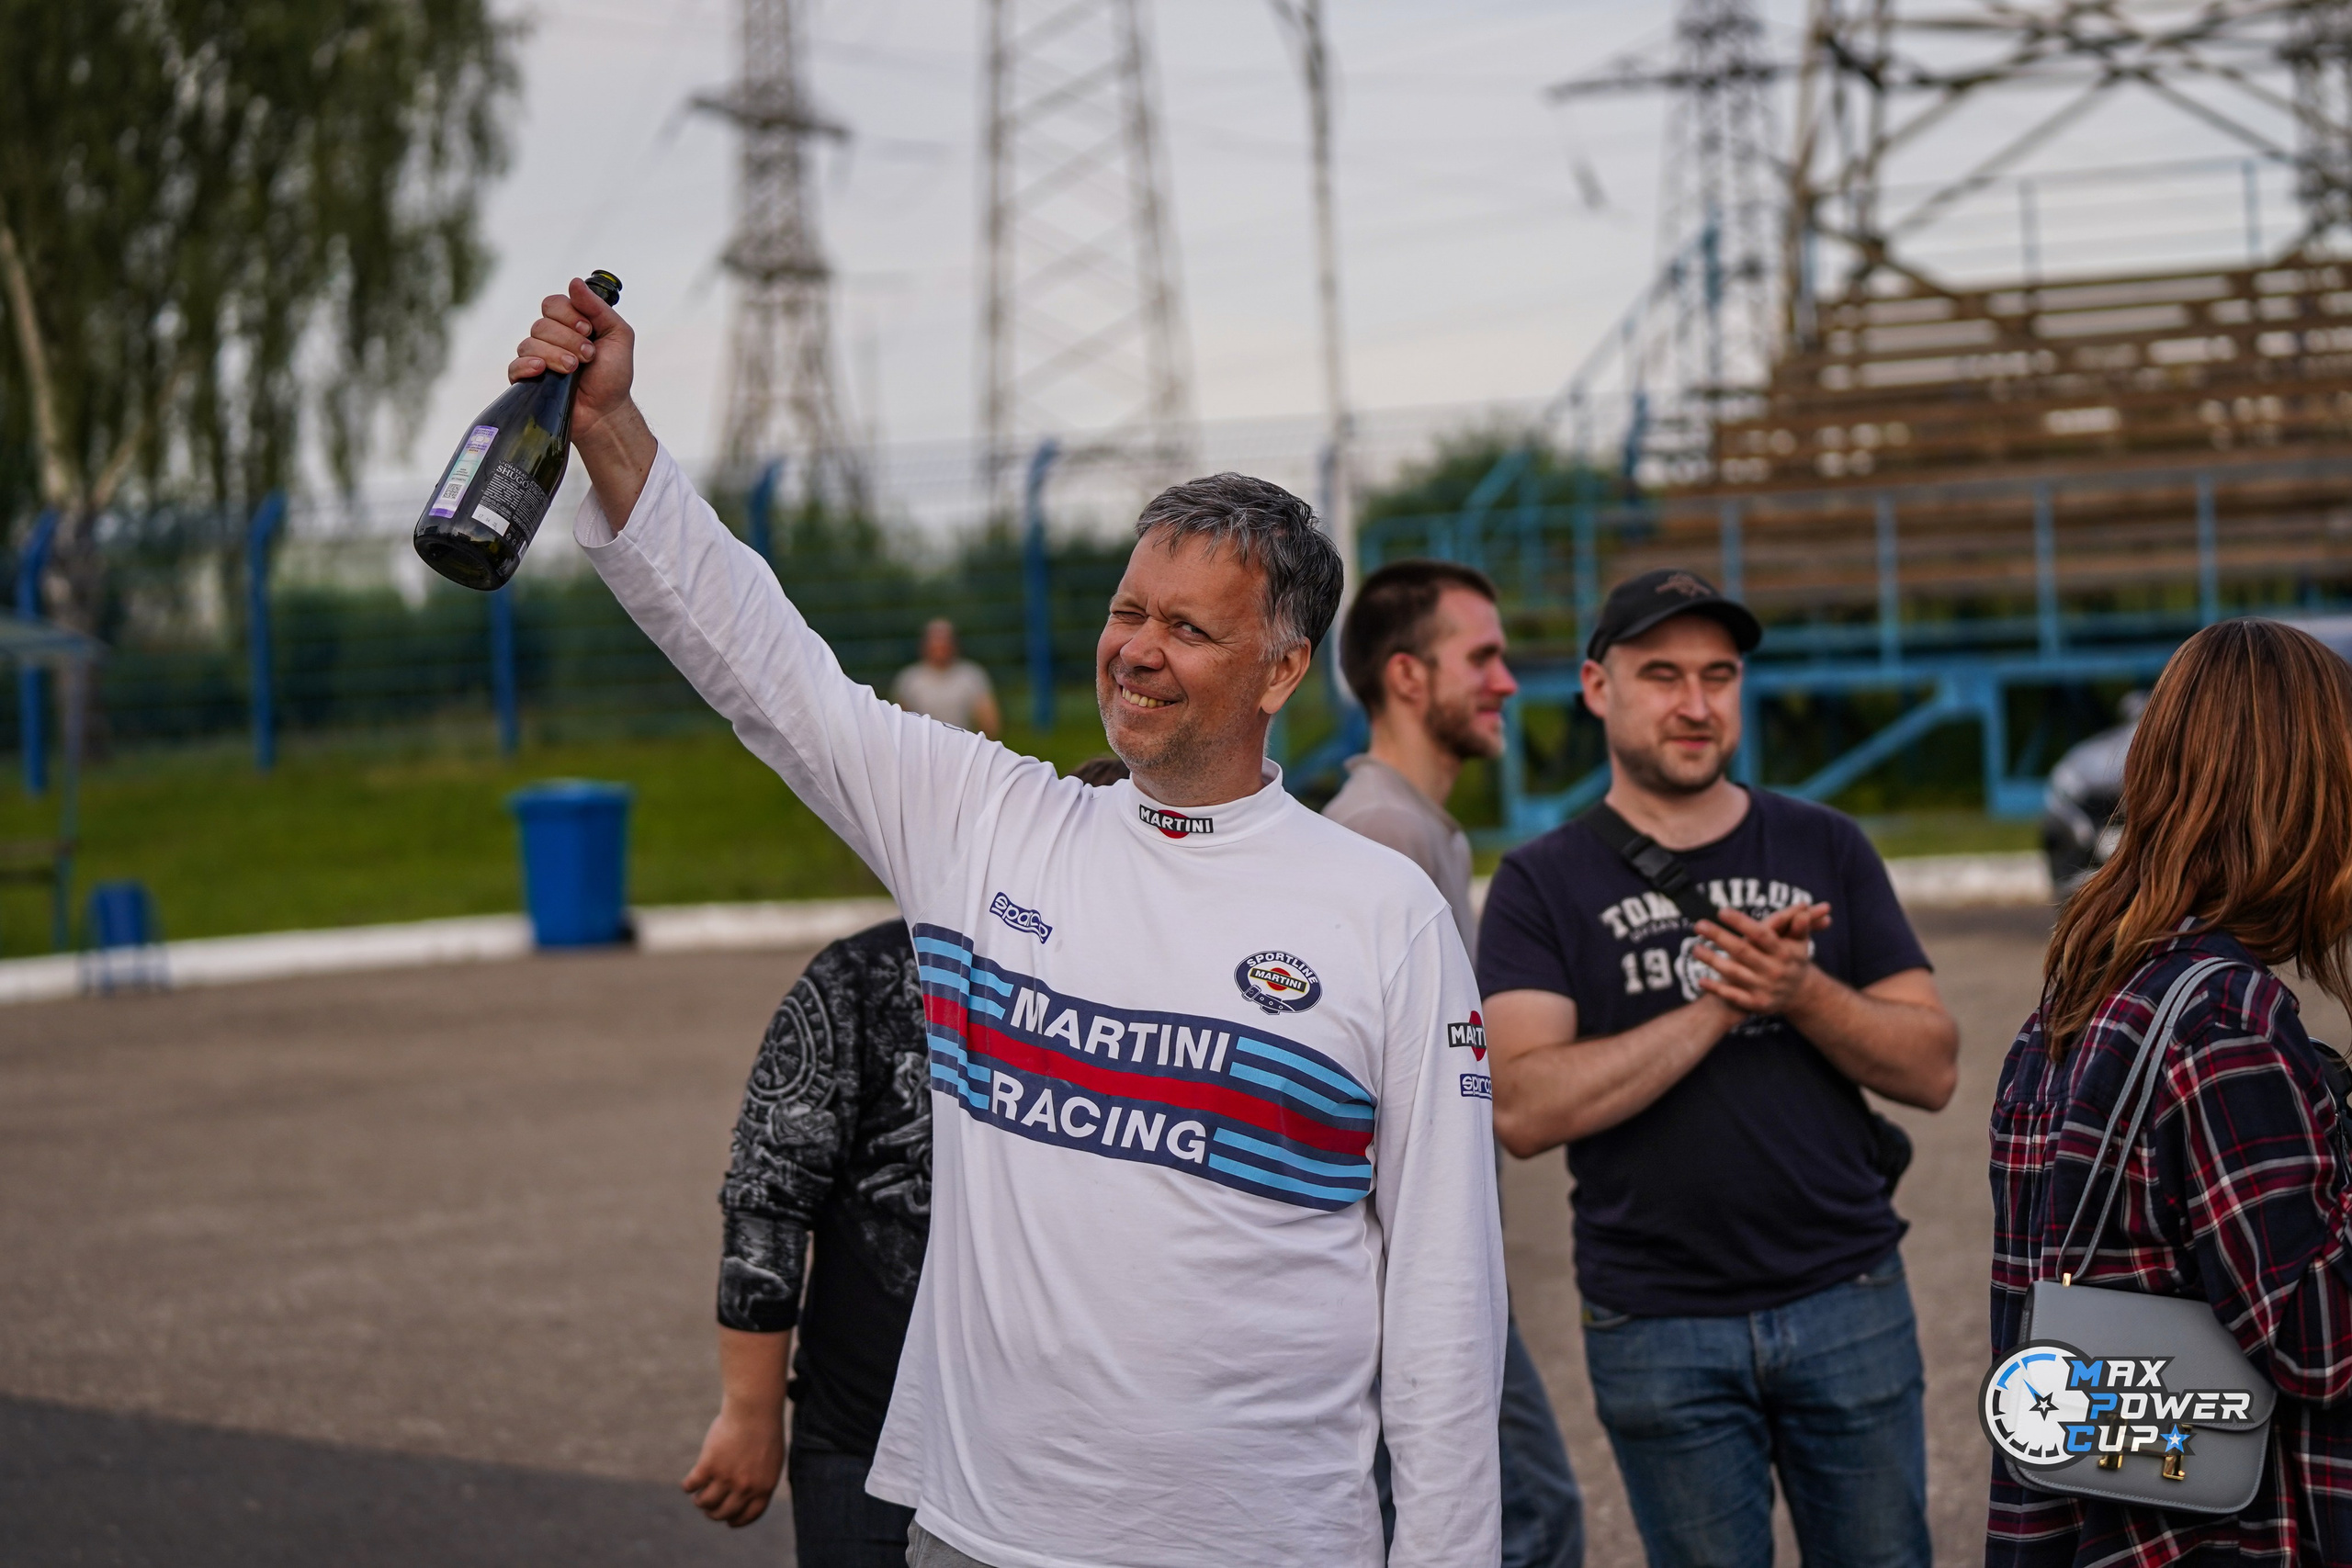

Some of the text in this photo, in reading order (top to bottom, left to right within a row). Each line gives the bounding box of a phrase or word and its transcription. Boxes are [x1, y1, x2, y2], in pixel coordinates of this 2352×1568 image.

[1140, 807, 1212, 833] MARTINI
[1600, 891, 1682, 941] TOM
[1696, 877, 1814, 910] AILOR
[1247, 953, 1318, 984] SPORTLINE
[1255, 970, 1302, 989] MARTINI
[1011, 987, 1231, 1073] MARTINI
[991, 1070, 1207, 1164] RACING
